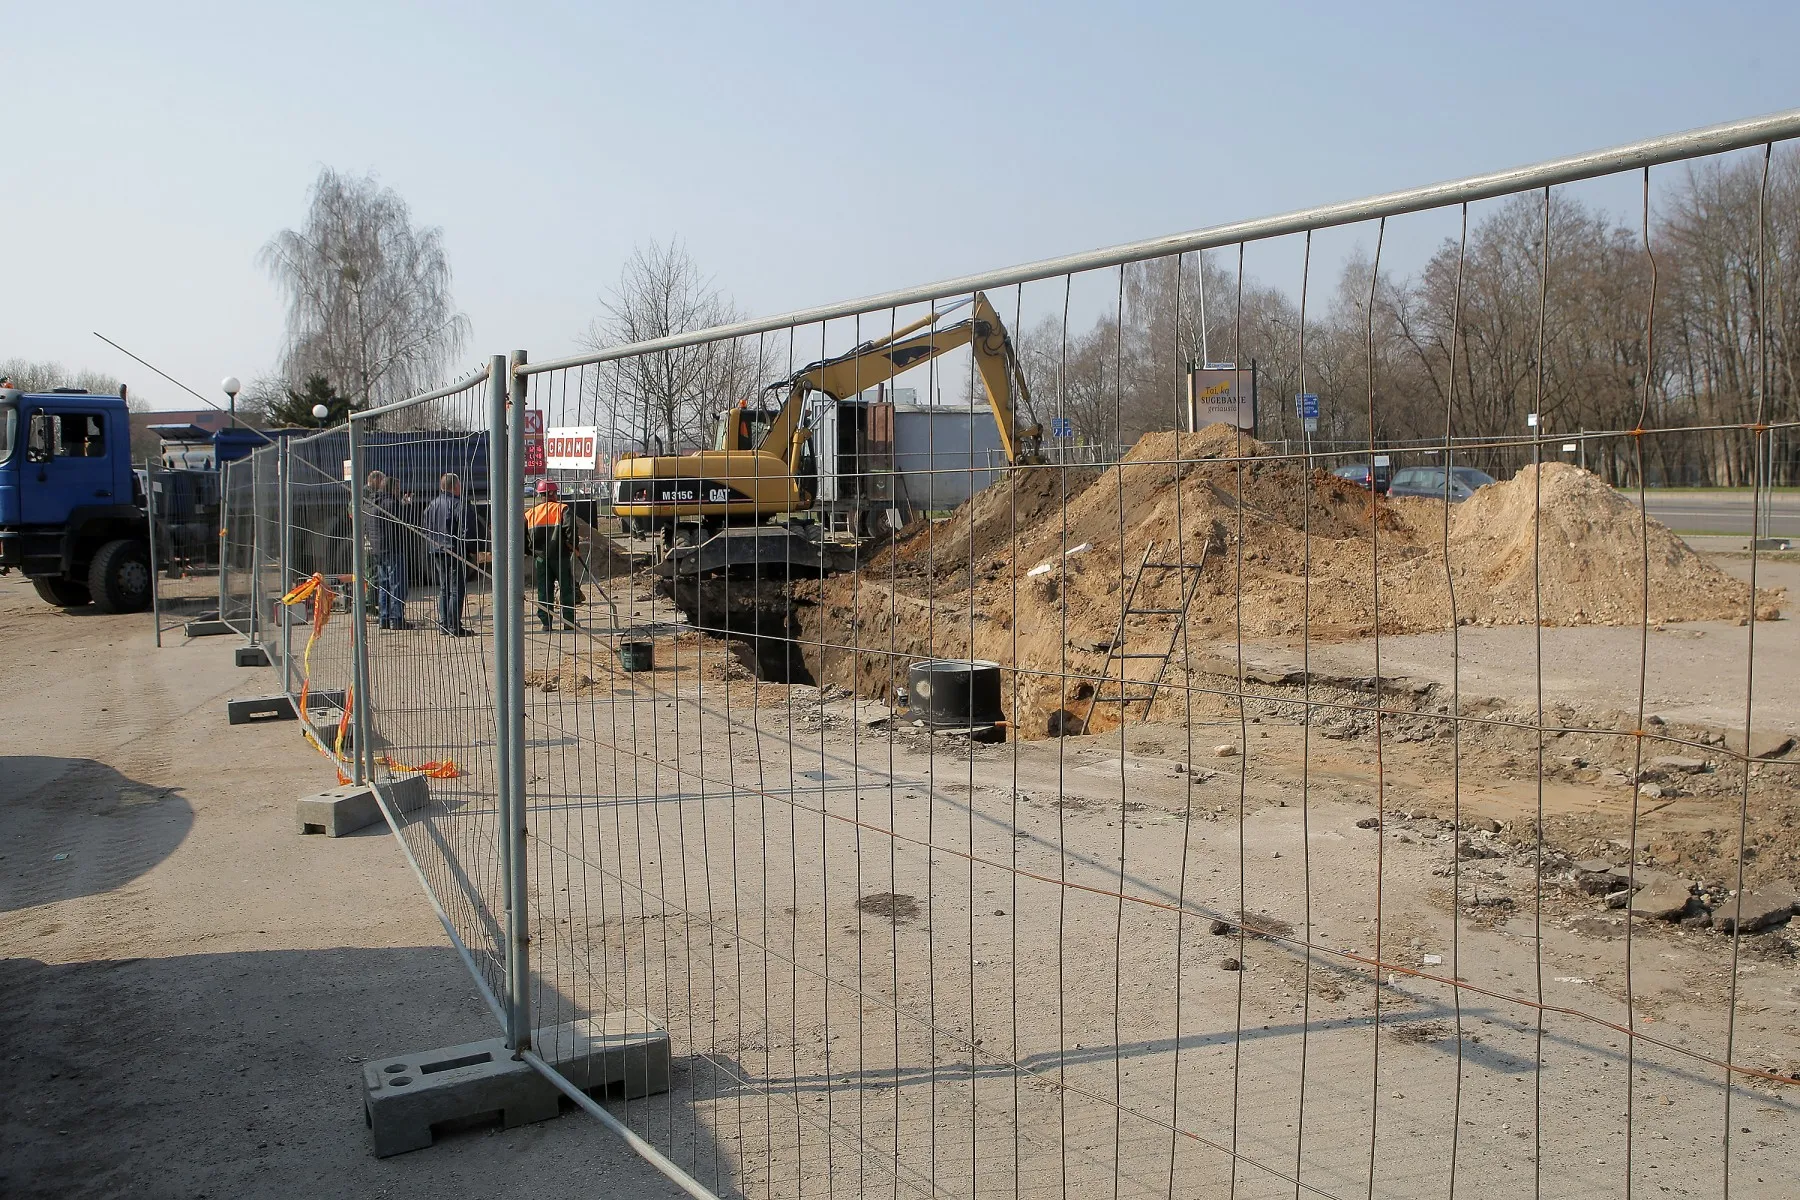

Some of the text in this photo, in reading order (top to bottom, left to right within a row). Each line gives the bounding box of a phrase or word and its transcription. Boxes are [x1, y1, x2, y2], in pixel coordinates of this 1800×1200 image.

[1207, 405, 1238, 413] geriausia
[549, 441, 592, 454] CRAMO
[662, 490, 693, 501] M315C
[709, 488, 731, 502] CAT
